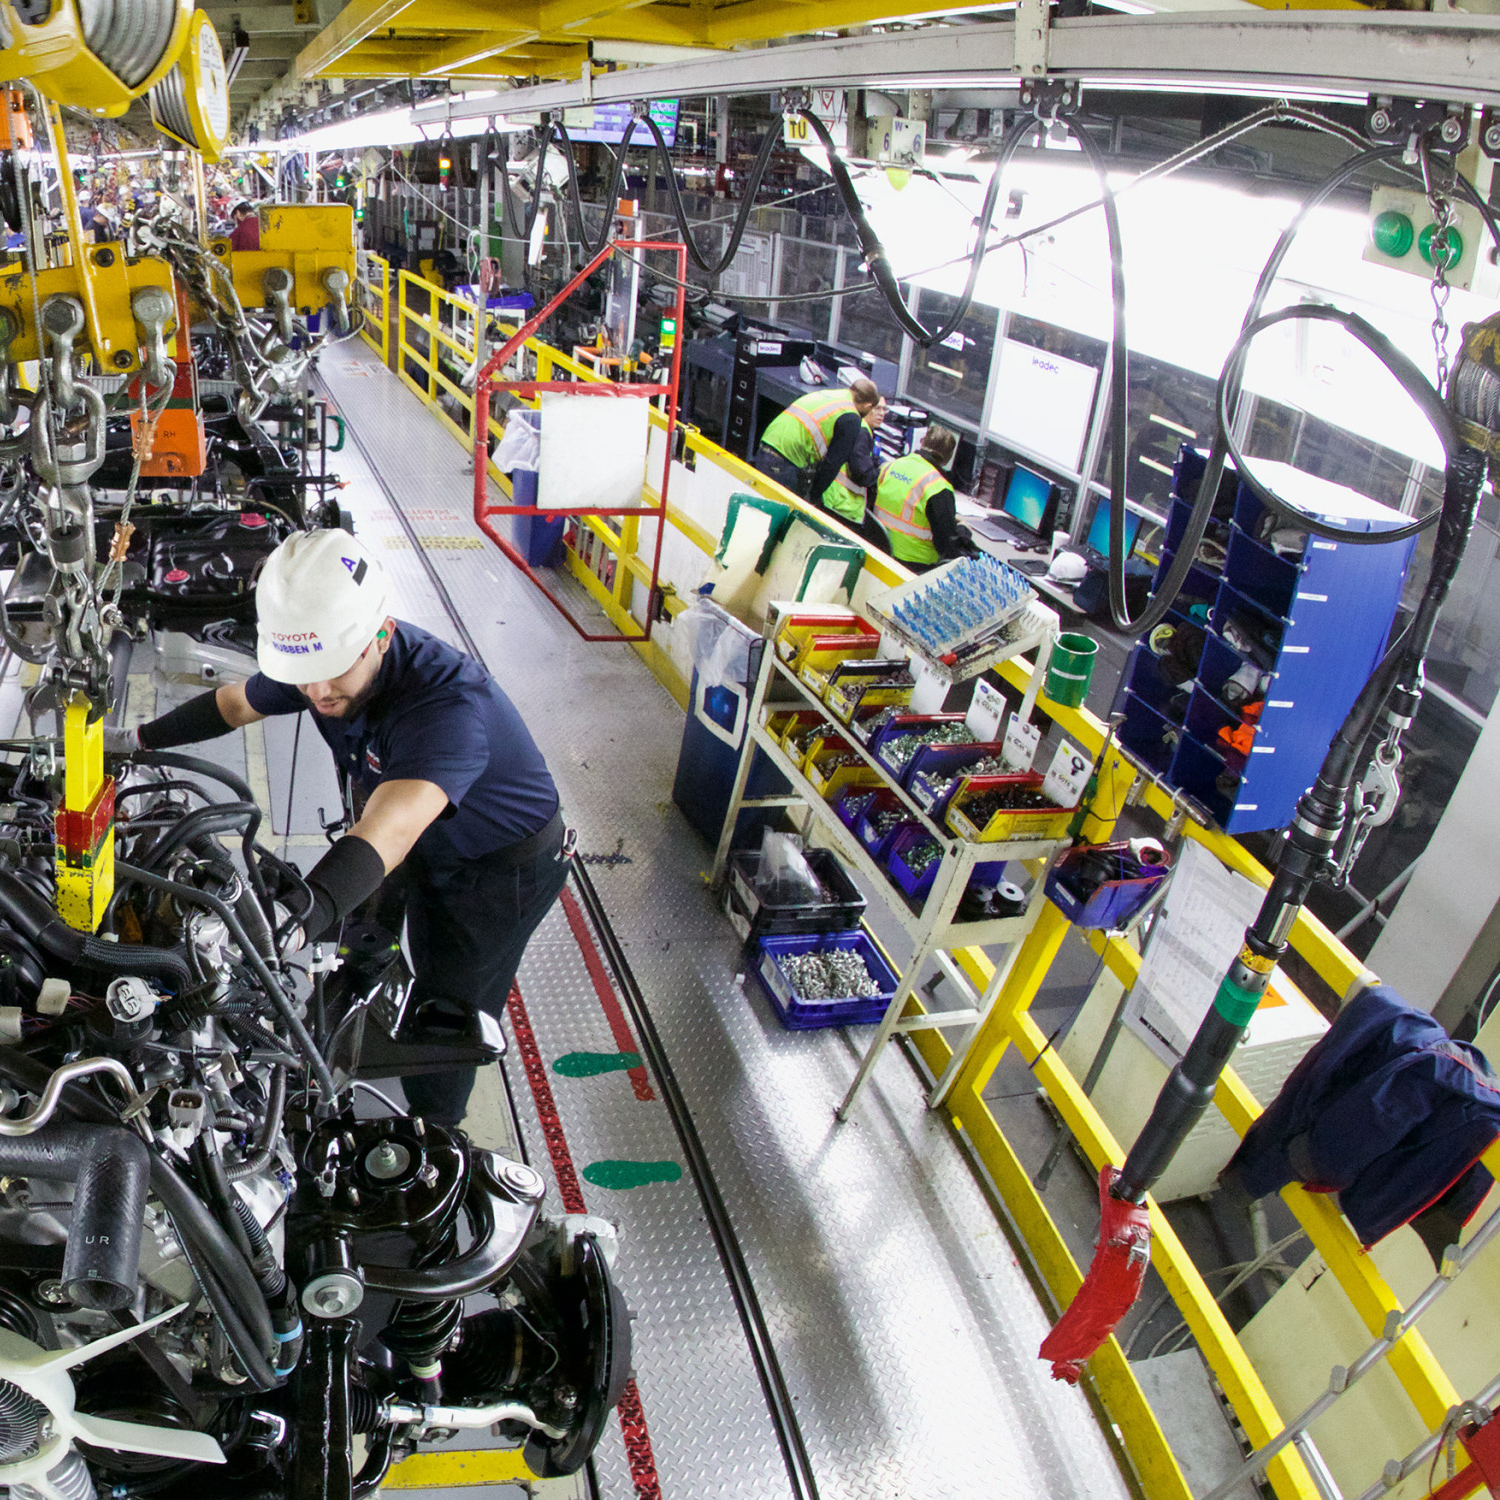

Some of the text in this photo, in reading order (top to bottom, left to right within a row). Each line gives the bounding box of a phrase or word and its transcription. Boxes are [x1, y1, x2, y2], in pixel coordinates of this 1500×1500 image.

[884, 132, 889, 151] 6
[913, 134, 921, 153] 6
[945, 336, 961, 347] adec
[1032, 356, 1059, 374] leadec
[164, 430, 175, 438] RH
[272, 632, 318, 642] TOYOTA
[313, 642, 323, 651] M
